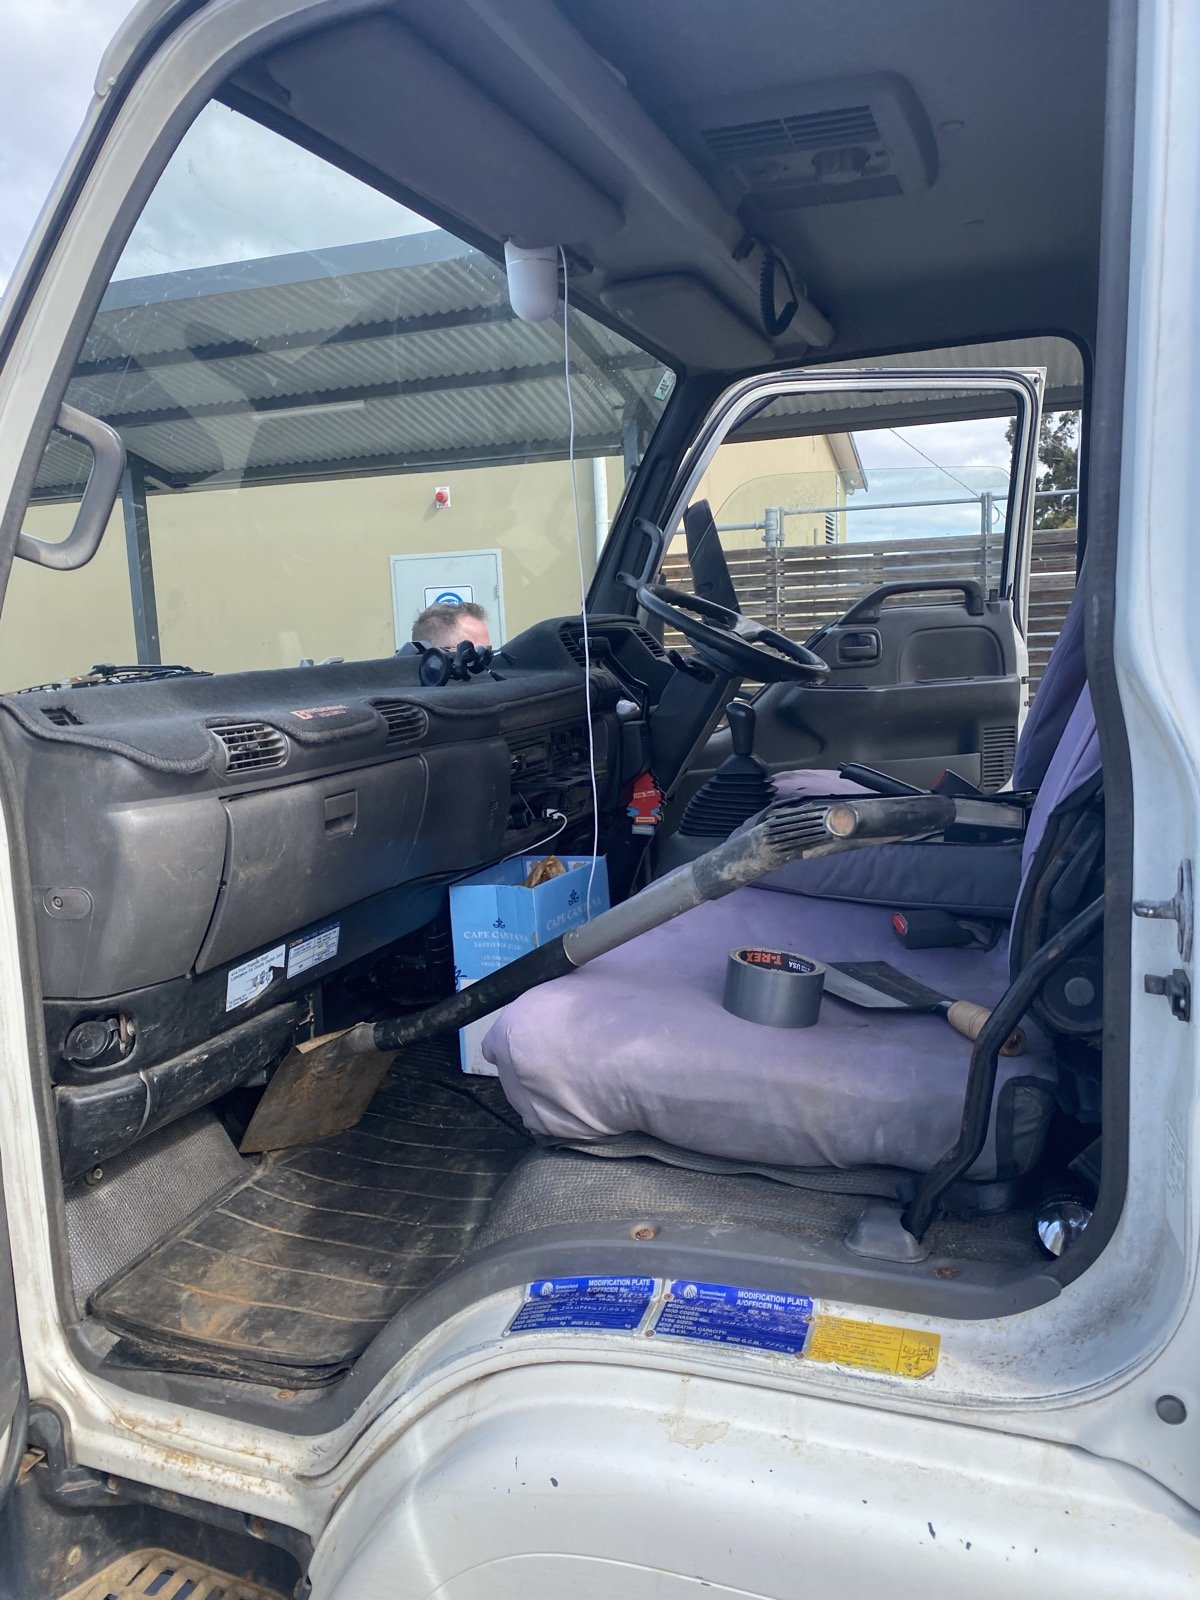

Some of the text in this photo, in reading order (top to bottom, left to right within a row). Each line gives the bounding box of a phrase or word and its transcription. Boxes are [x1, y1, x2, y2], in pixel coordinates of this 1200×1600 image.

[463, 930, 529, 943] CAPE CANTANA
[746, 951, 782, 966] T-REX
[788, 960, 801, 971] USA
[631, 1279, 651, 1287] PLATE
[737, 1290, 809, 1307] MODIFICATION PLATE
[736, 1299, 772, 1311] A/OFFICER
